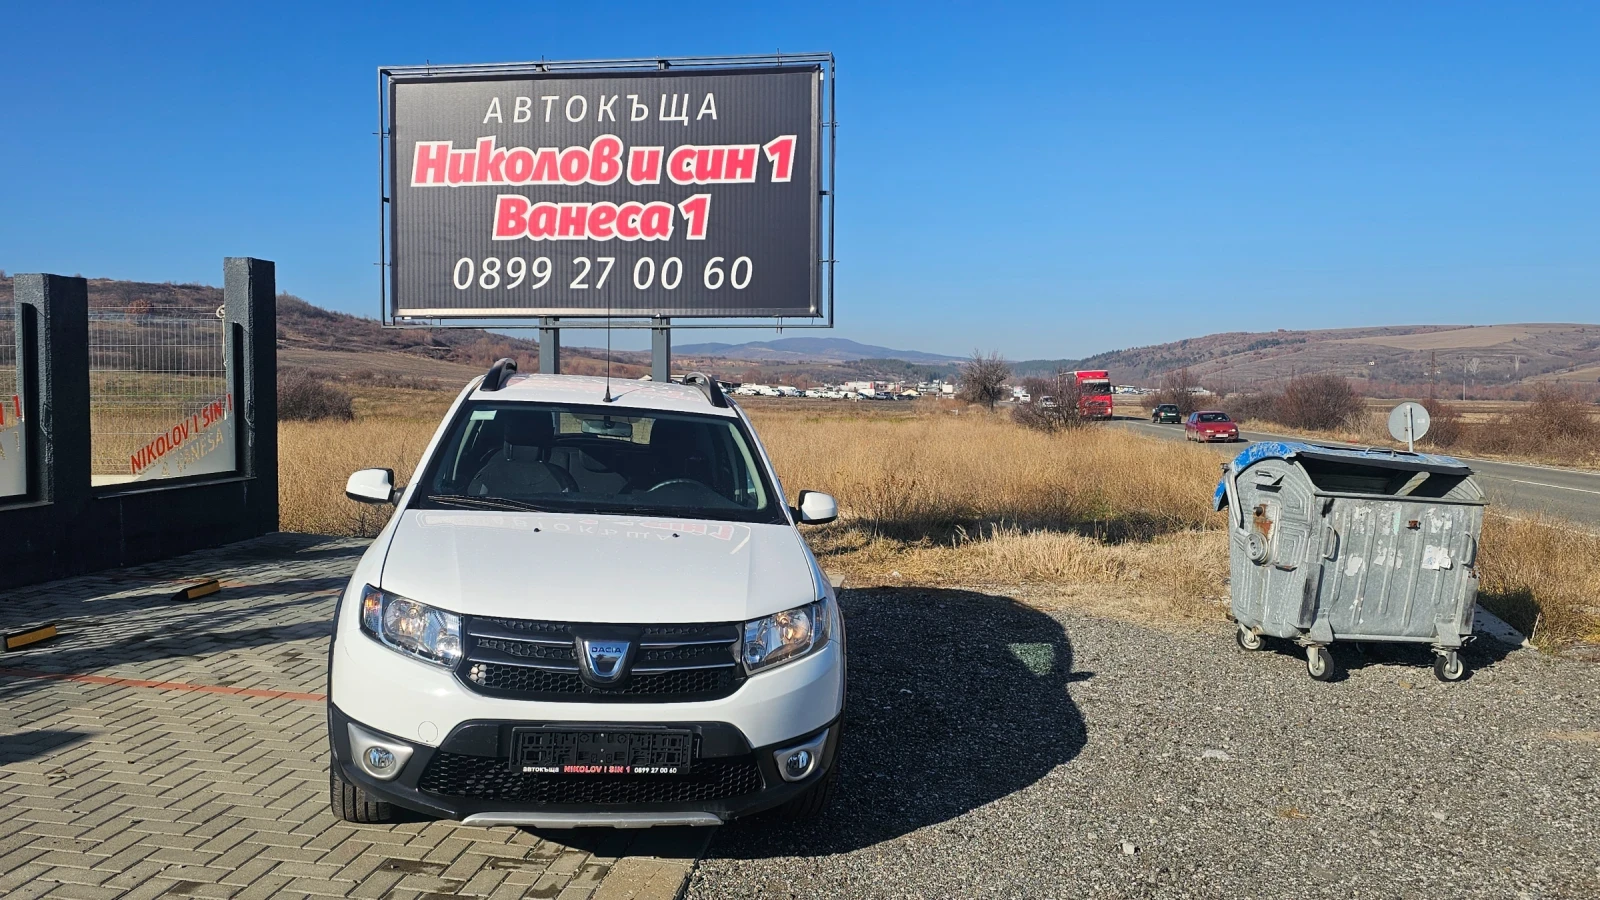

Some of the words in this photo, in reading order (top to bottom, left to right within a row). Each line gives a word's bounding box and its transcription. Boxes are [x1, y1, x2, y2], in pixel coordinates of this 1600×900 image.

[483, 92, 718, 126] АВТОКЪЩА
[411, 134, 623, 187] Николов
[626, 146, 664, 186] и
[666, 144, 760, 185] син
[762, 135, 797, 182] 1
[492, 194, 674, 241] Ванеса
[678, 194, 711, 240] 1
[453, 256, 552, 290] 0899
[569, 256, 615, 290] 27
[633, 256, 683, 290] 00
[703, 256, 753, 290] 60
[130, 419, 189, 475] NIKOLOV
[202, 399, 222, 428] SIN
[563, 765, 602, 773] NIKOLOV
[608, 765, 624, 773] SIN
